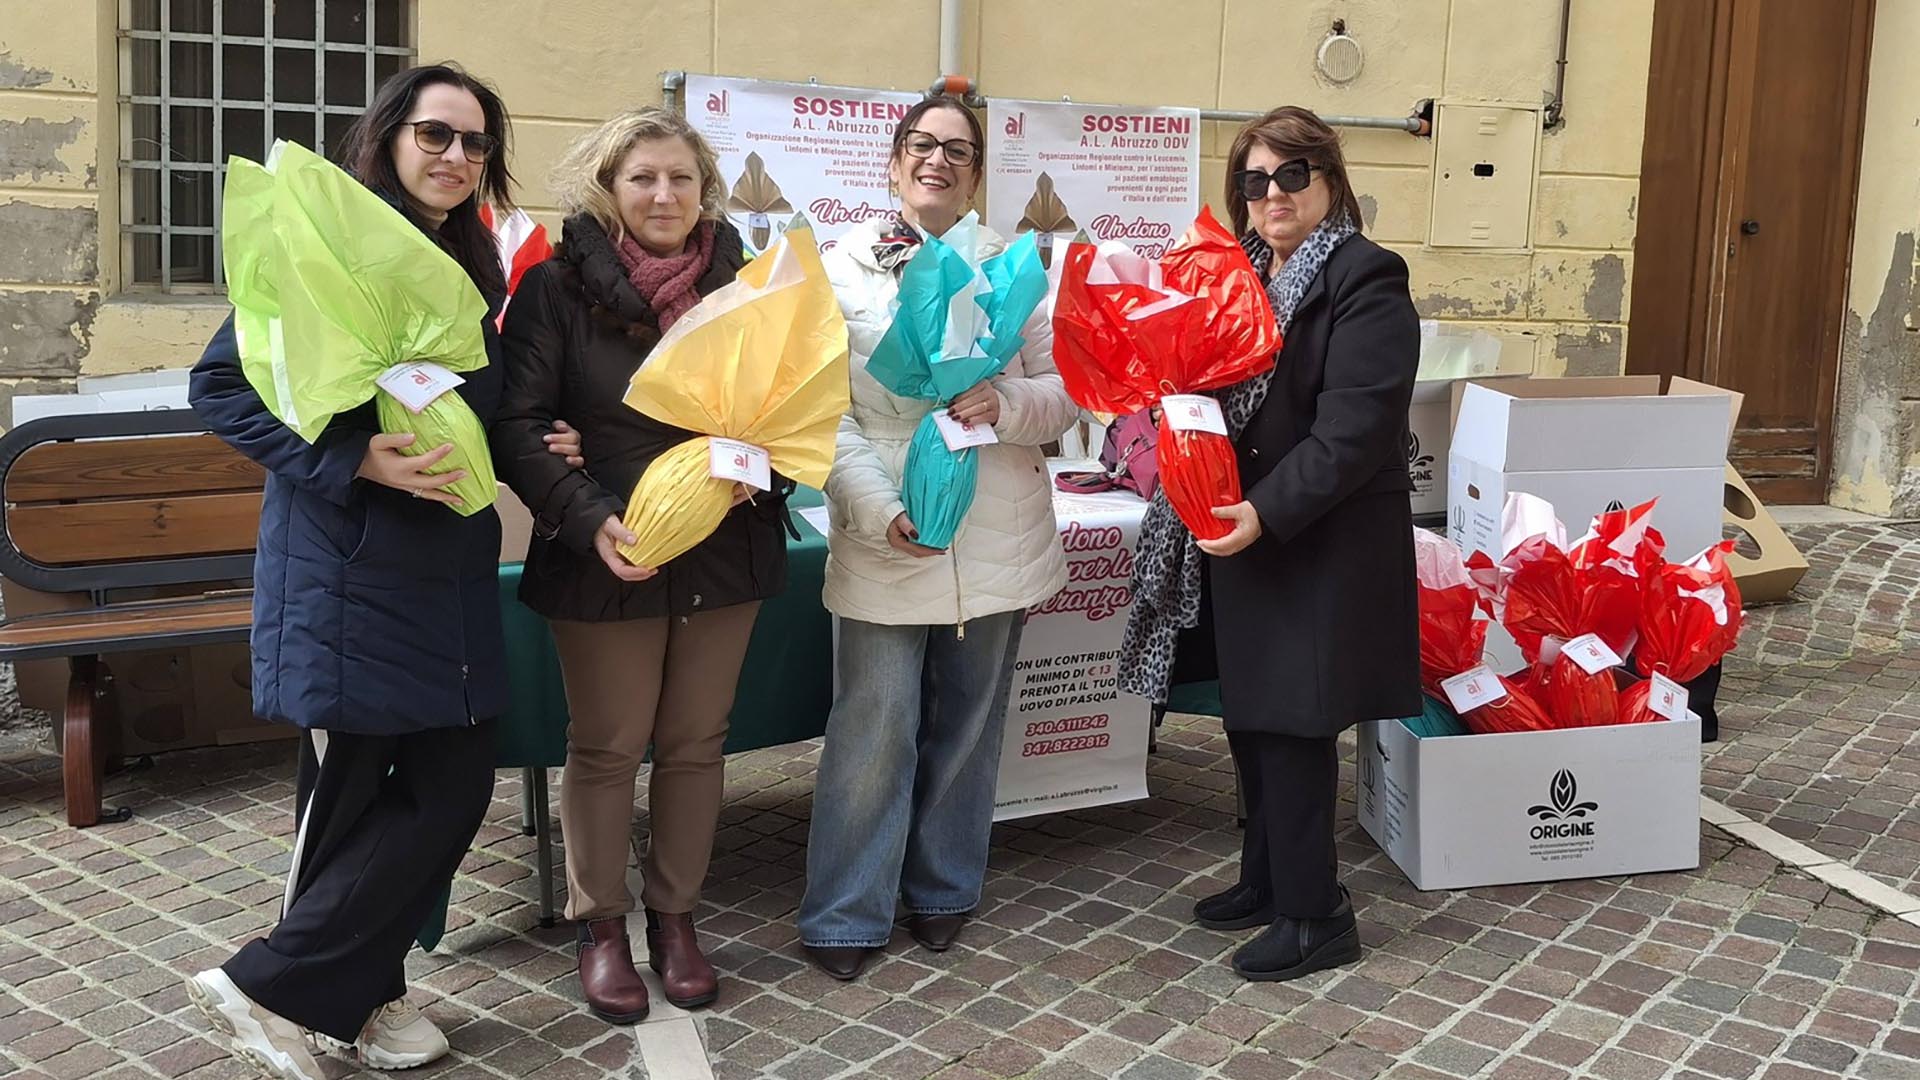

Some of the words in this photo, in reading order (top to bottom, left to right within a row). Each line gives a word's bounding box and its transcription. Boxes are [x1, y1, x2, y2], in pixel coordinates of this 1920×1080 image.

[827, 119, 879, 135] Abruzzo
[1082, 115, 1190, 133] SOSTIENI
[745, 131, 801, 143] Organizzazione
[803, 135, 840, 147] Regionale
[842, 139, 865, 147] contro
[1080, 135, 1106, 147] A.L.
[1111, 136, 1158, 148] Abruzzo
[1163, 137, 1189, 149] ODV
[1038, 151, 1088, 161] Organizzazione
[1089, 153, 1122, 162] Regionale
[825, 169, 866, 178] provenienti
[1122, 175, 1148, 183] pazienti
[1150, 175, 1188, 184] ematologici
[1107, 185, 1143, 193] provenienti
[1170, 186, 1187, 194] parte
[809, 198, 848, 225] Un
[1091, 214, 1127, 240] Un
[1126, 216, 1171, 239] dono
[1408, 469, 1432, 481] GINE
[1060, 521, 1123, 553] dono
[1023, 585, 1132, 625] peranza
[1015, 660, 1033, 671] ON
[1035, 657, 1052, 669] UN
[1054, 650, 1121, 666] CONTRIBUT
[1025, 670, 1071, 684] MINIMO
[1072, 668, 1085, 679] DI
[1099, 665, 1111, 675] 13
[1020, 683, 1076, 699] PRENOTA
[1079, 681, 1088, 691] IL
[1093, 678, 1116, 689] TUO
[1019, 699, 1053, 712] UOVO
[1055, 697, 1067, 707] DI
[1069, 691, 1117, 705] PASQUA
[1025, 714, 1109, 737] 340.6111242
[1022, 733, 1110, 757] 347.8222812
[1530, 822, 1595, 839] ORIGINE
